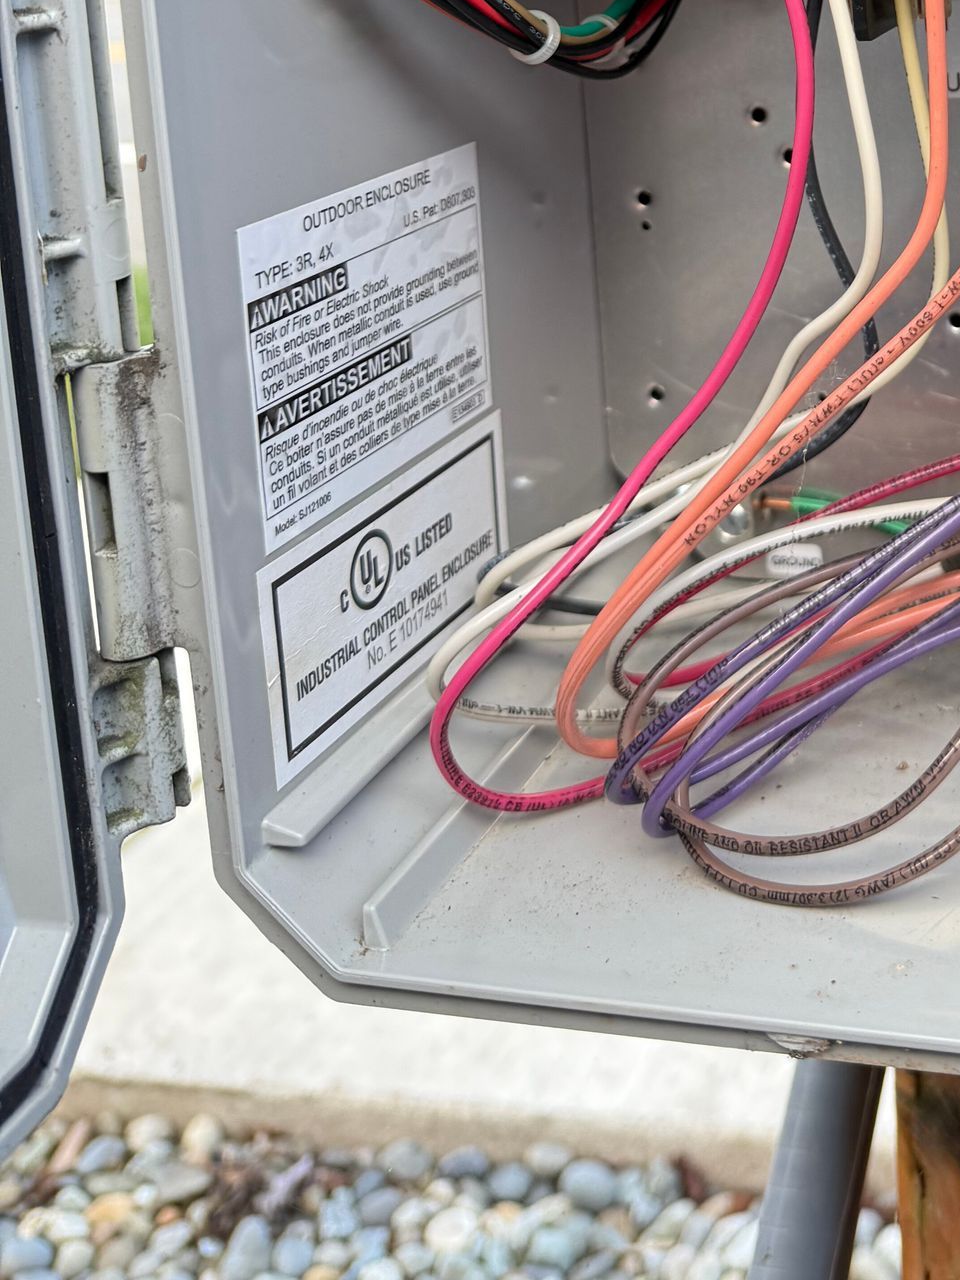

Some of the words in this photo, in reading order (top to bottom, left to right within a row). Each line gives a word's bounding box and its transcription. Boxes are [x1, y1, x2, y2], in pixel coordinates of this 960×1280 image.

[302, 195, 364, 233] OUTDOOR
[365, 168, 432, 208] ENCLOSURE
[254, 260, 293, 289] TYPE:
[295, 251, 316, 273] 3R,
[318, 241, 334, 262] 4X
[262, 267, 347, 324] WARNING
[254, 326, 278, 350] Risk
[279, 318, 291, 338] of
[292, 313, 312, 332] Fire
[313, 307, 325, 322] or
[326, 289, 360, 317] Electric
[362, 274, 389, 299] Shock
[258, 344, 282, 365] This
[283, 321, 331, 354] enclosure
[333, 309, 356, 330] does
[356, 298, 373, 318] not
[373, 284, 405, 313] provide
[405, 265, 446, 297] grounding
[260, 351, 306, 382] conduits.
[307, 335, 337, 358] When
[338, 315, 373, 344] metallic
[373, 298, 406, 325] conduit
[405, 296, 414, 309] is
[414, 284, 437, 304] used,
[438, 276, 453, 292] use
[262, 378, 285, 402] type
[286, 355, 330, 387] bushings
[331, 341, 350, 363] and
[351, 327, 383, 357] jumper
[382, 318, 404, 336] wire.
[275, 337, 411, 433] AVERTISSEMENT
[265, 433, 300, 463] Risque
[302, 404, 349, 441] d'incendie
[350, 396, 364, 413] ou
[364, 388, 376, 405] de
[377, 376, 399, 397] choc
[269, 459, 284, 477] Ce
[315, 418, 356, 450] n'assure
[357, 407, 374, 428] pas
[374, 399, 387, 415] de
[387, 386, 408, 407] mise
[270, 460, 315, 494] conduits.
[316, 447, 327, 466] Si
[328, 443, 341, 459] un
[342, 420, 376, 450] conduit
[272, 493, 286, 510] un
[287, 483, 297, 502] fil
[297, 465, 328, 494] volant
[328, 458, 339, 475] et
[340, 449, 358, 468] des
[358, 429, 389, 457] colliers
[390, 421, 402, 437] de
[274, 514, 298, 537] Model:
[395, 543, 411, 572] US
[415, 512, 453, 557] LISTED
[359, 549, 385, 595] UL
[296, 635, 362, 702] INDUSTRIAL
[363, 597, 411, 648] CONTROL
[410, 573, 442, 609] PANEL
[441, 529, 492, 584] ENCLOSURE
[366, 645, 387, 671] No.
[388, 628, 398, 653] E
[399, 588, 448, 641] 10174941
